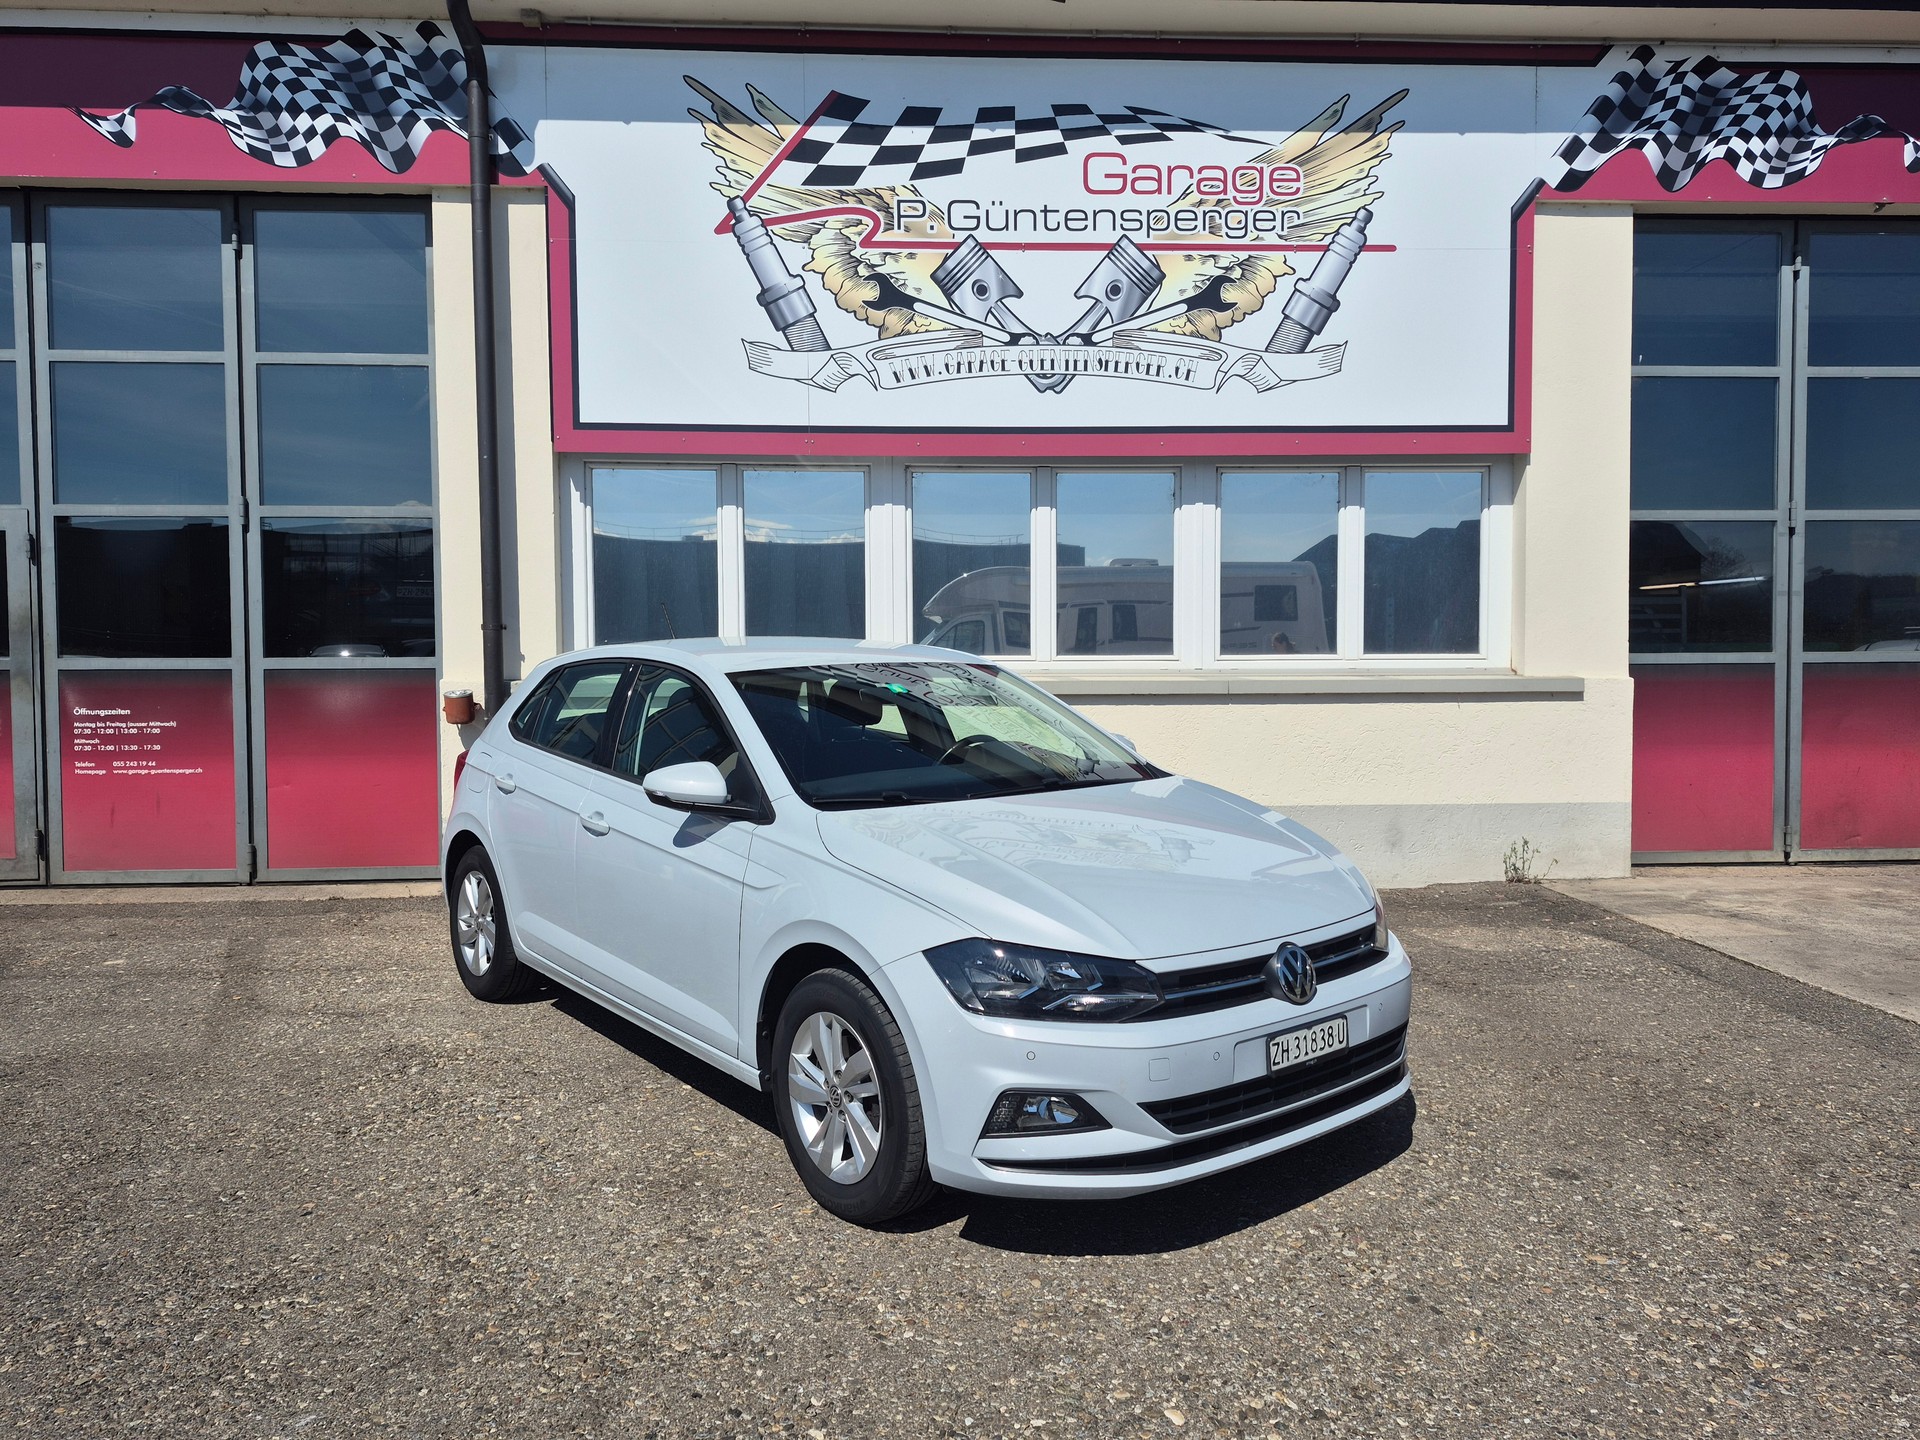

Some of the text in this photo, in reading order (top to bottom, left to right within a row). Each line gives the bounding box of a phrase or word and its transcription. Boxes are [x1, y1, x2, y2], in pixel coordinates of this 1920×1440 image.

[1083, 152, 1301, 206] Garage
[896, 199, 1301, 239] P. Güntensperger
[889, 349, 1200, 384] WWW.GARAGE-GUENTENSPERGER.CH
[73, 707, 131, 717] Öffnungszeiten
[148, 720, 177, 728] Mittwoch)
